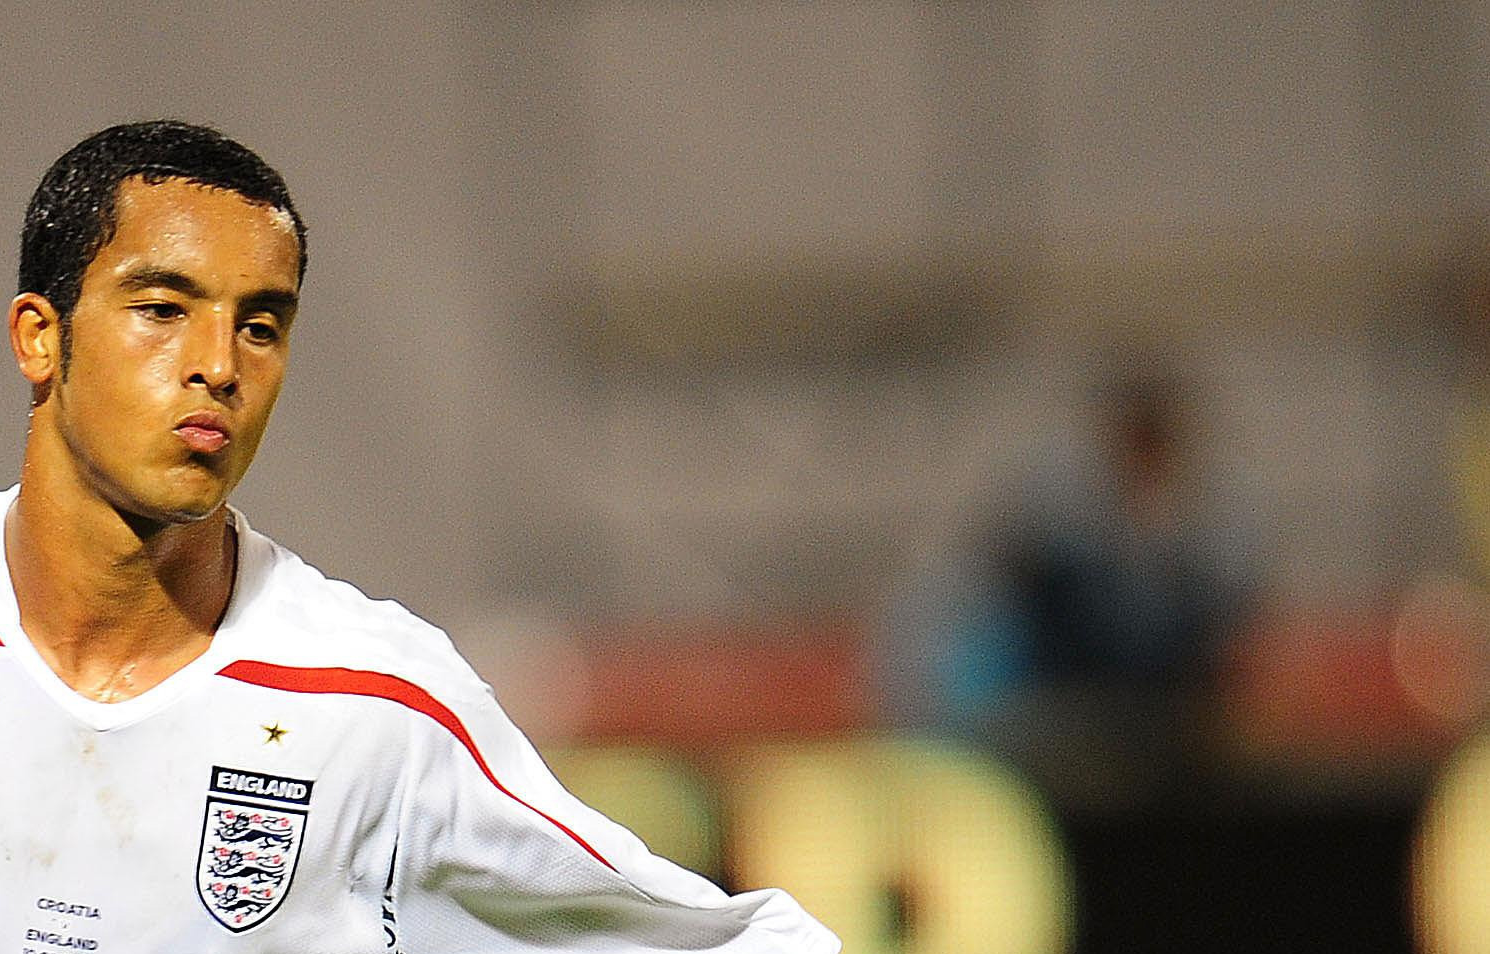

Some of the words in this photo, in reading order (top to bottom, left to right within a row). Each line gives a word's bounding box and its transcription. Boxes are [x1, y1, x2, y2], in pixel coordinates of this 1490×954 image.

[216, 771, 307, 799] ENGLAND
[37, 898, 102, 920] CROATIA
[26, 928, 98, 950] ENGLAND
